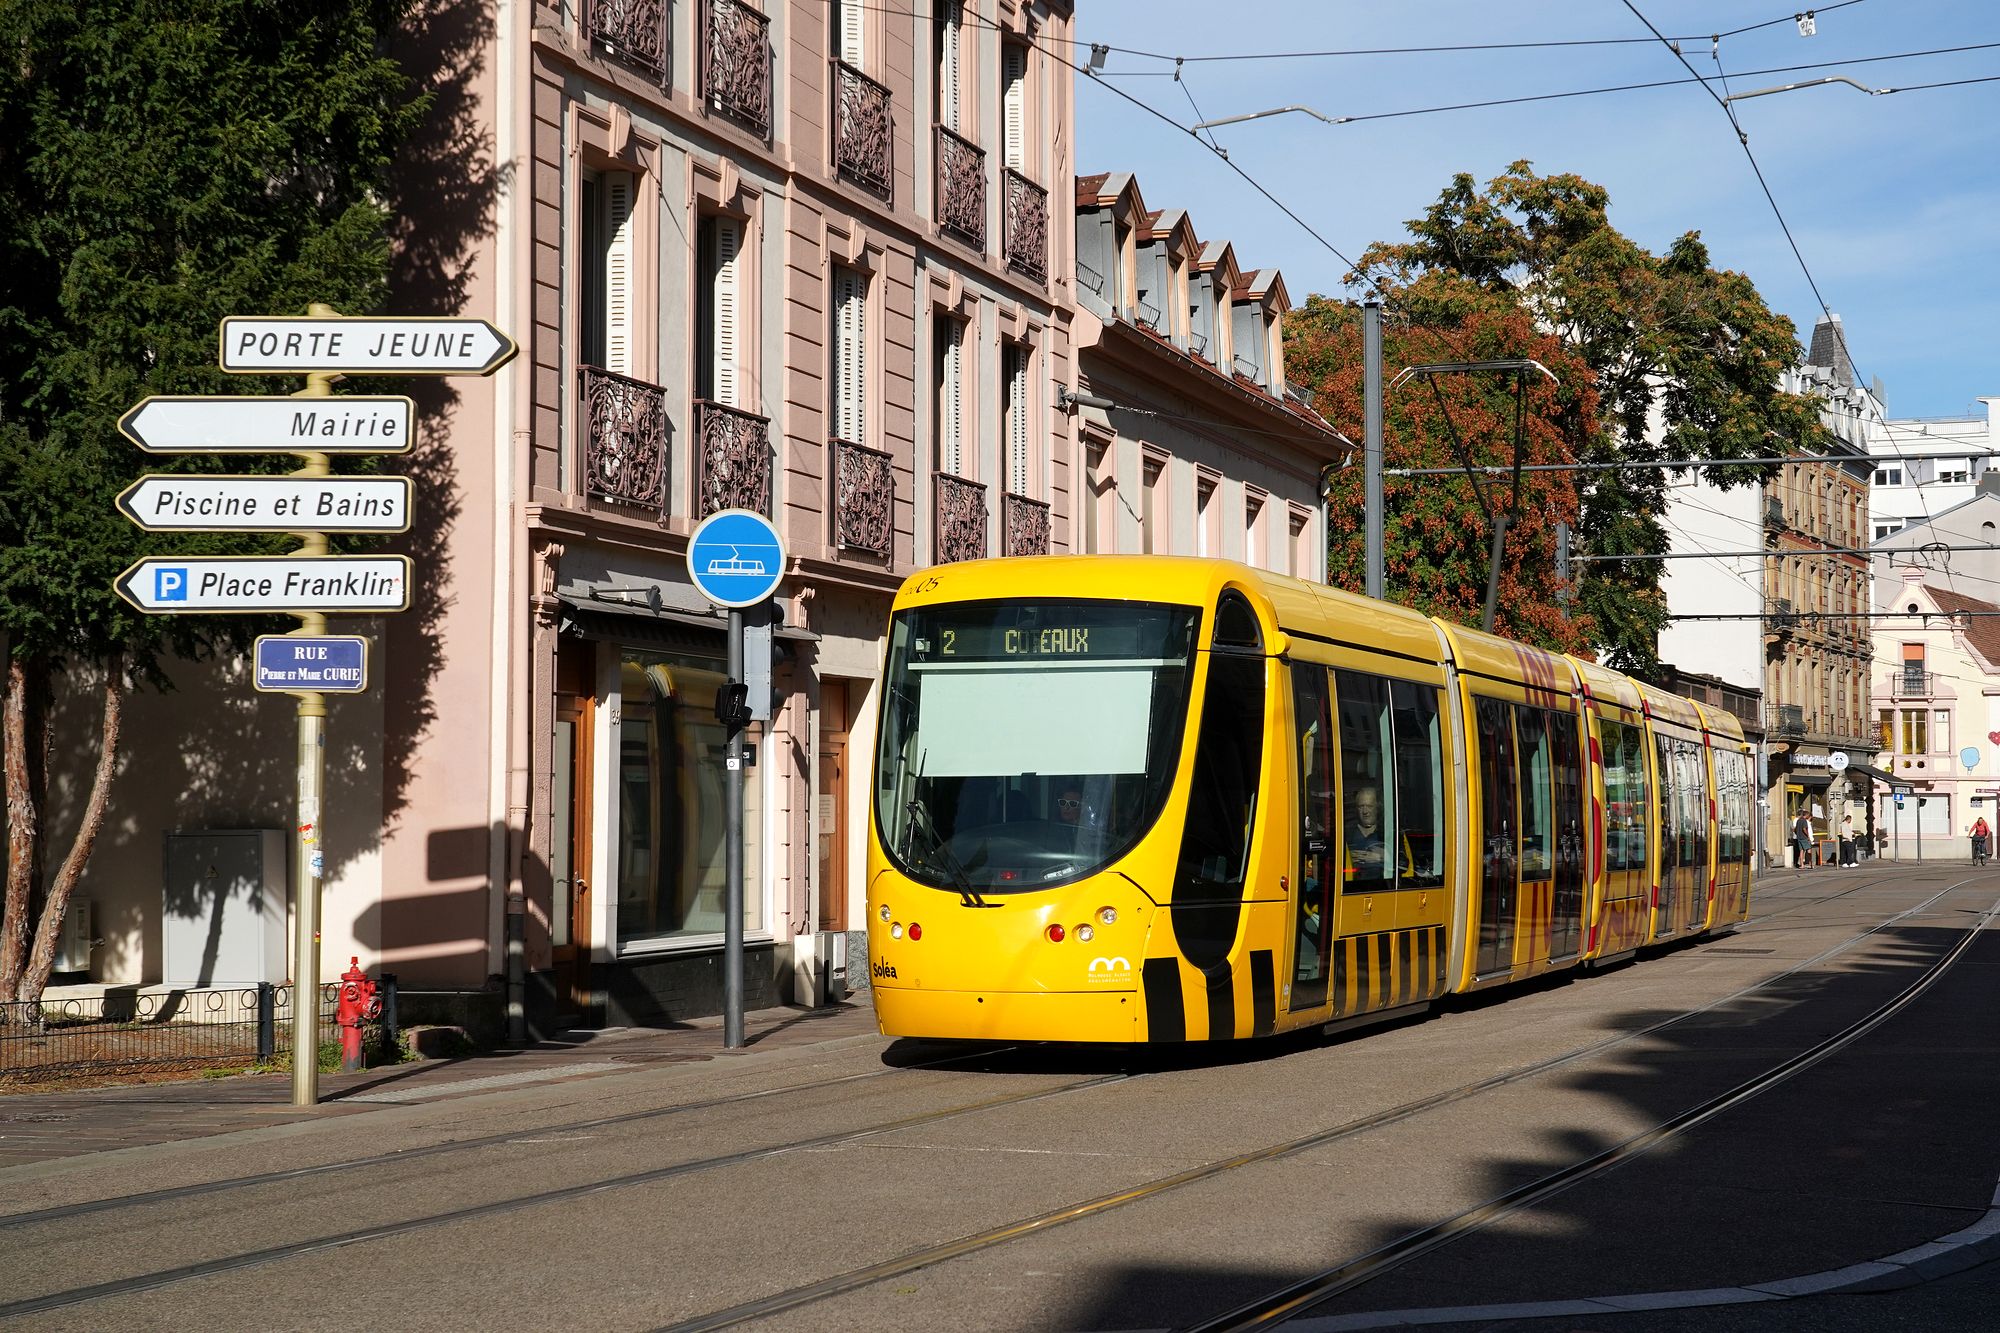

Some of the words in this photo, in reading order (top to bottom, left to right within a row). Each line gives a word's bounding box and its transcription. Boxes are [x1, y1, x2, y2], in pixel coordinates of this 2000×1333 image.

[238, 332, 343, 357] PORTE
[369, 333, 474, 357] JEUNE
[291, 412, 396, 437] Mairie
[155, 491, 257, 516] Piscine
[273, 493, 301, 516] et
[316, 491, 394, 517] Bains
[160, 572, 182, 598] P
[199, 572, 272, 597] Place
[283, 571, 393, 596] Franklin
[294, 646, 328, 660] RUE
[943, 630, 956, 654] 2
[323, 668, 360, 681] CURIE
